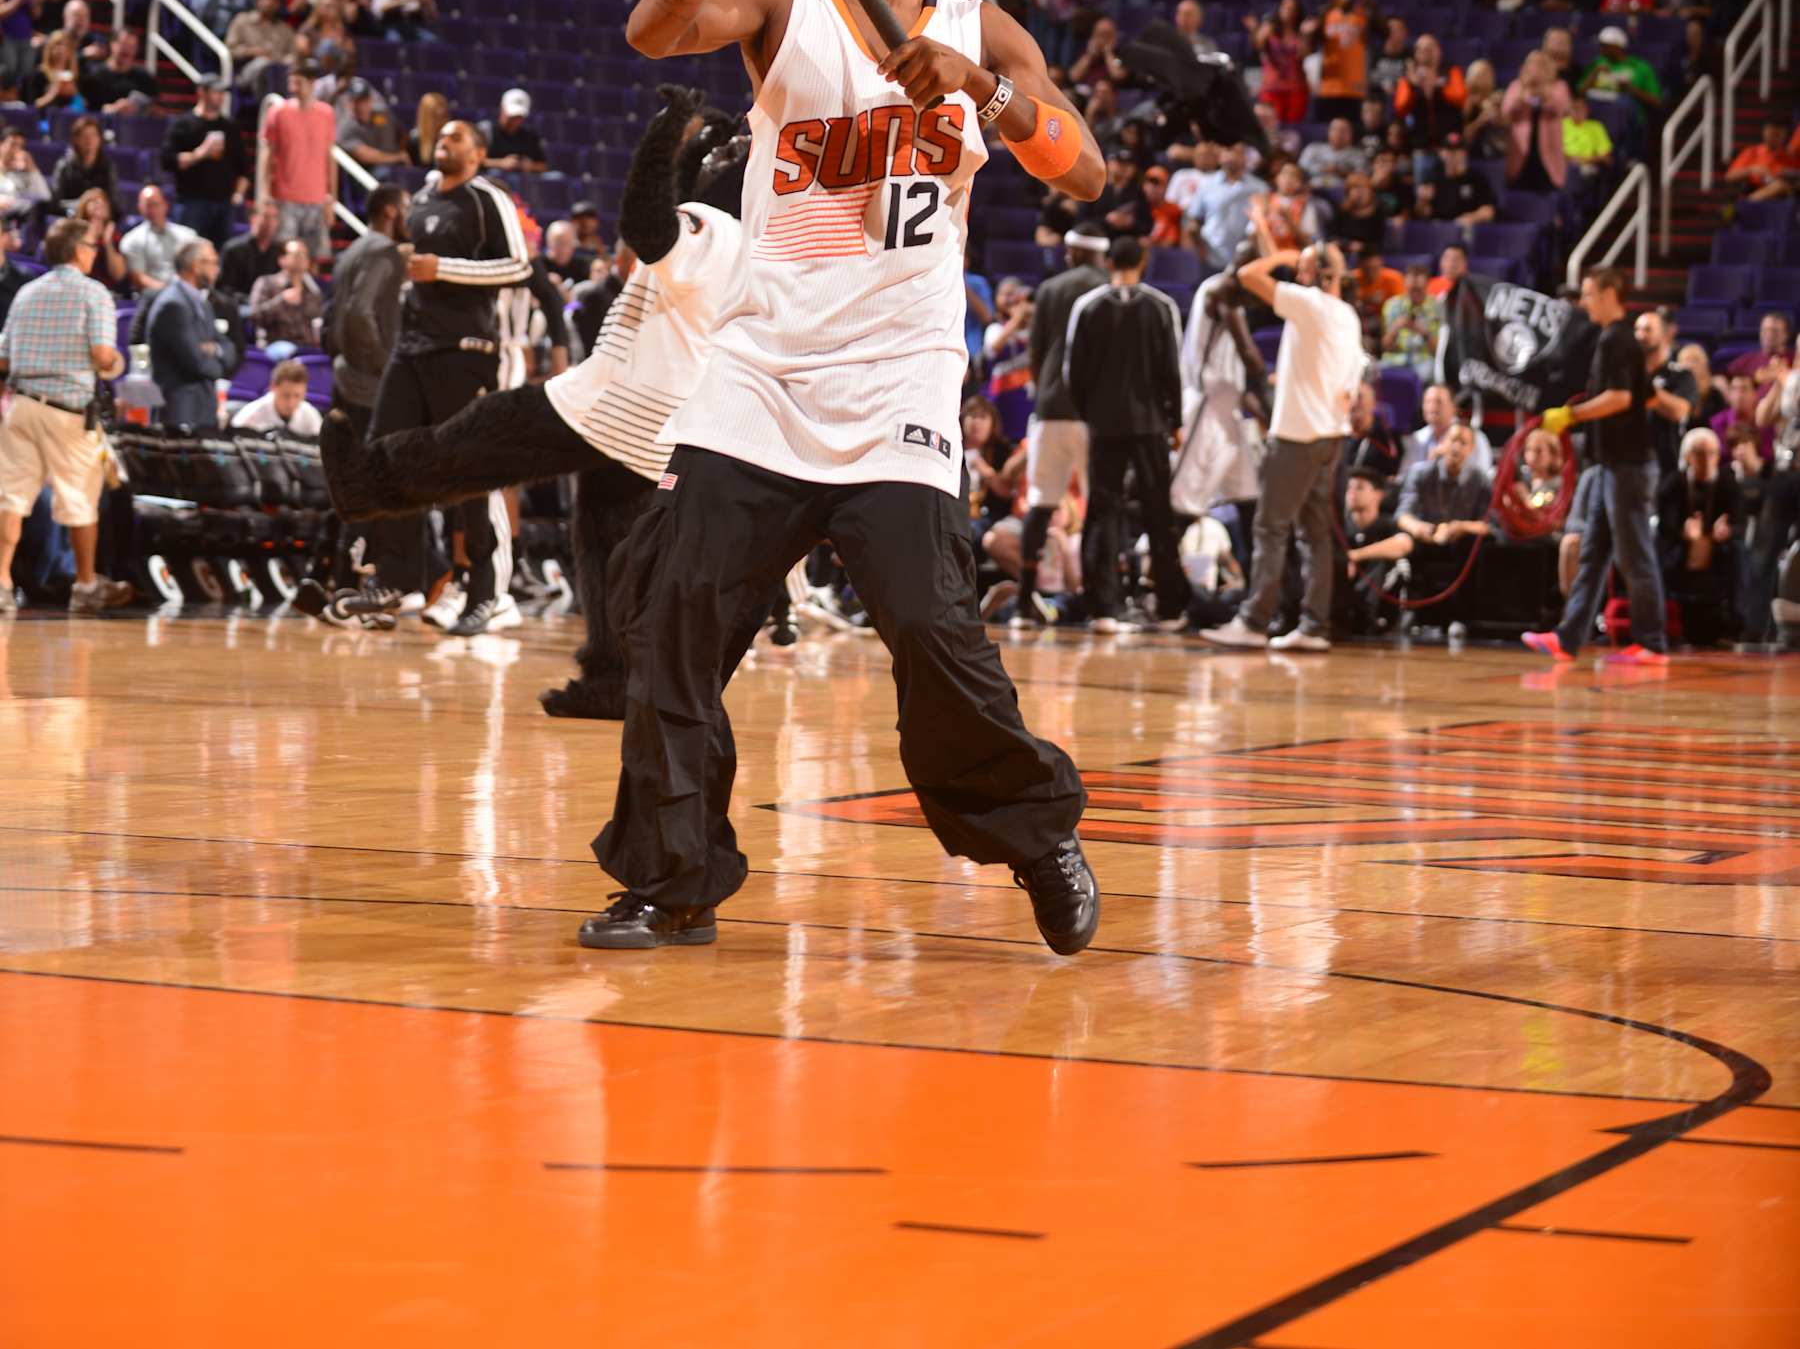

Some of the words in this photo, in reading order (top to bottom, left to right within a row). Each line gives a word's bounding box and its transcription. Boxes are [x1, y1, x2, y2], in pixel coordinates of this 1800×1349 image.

[773, 103, 965, 196] SUNS
[884, 181, 939, 251] 12
[1484, 282, 1571, 338] NETS
